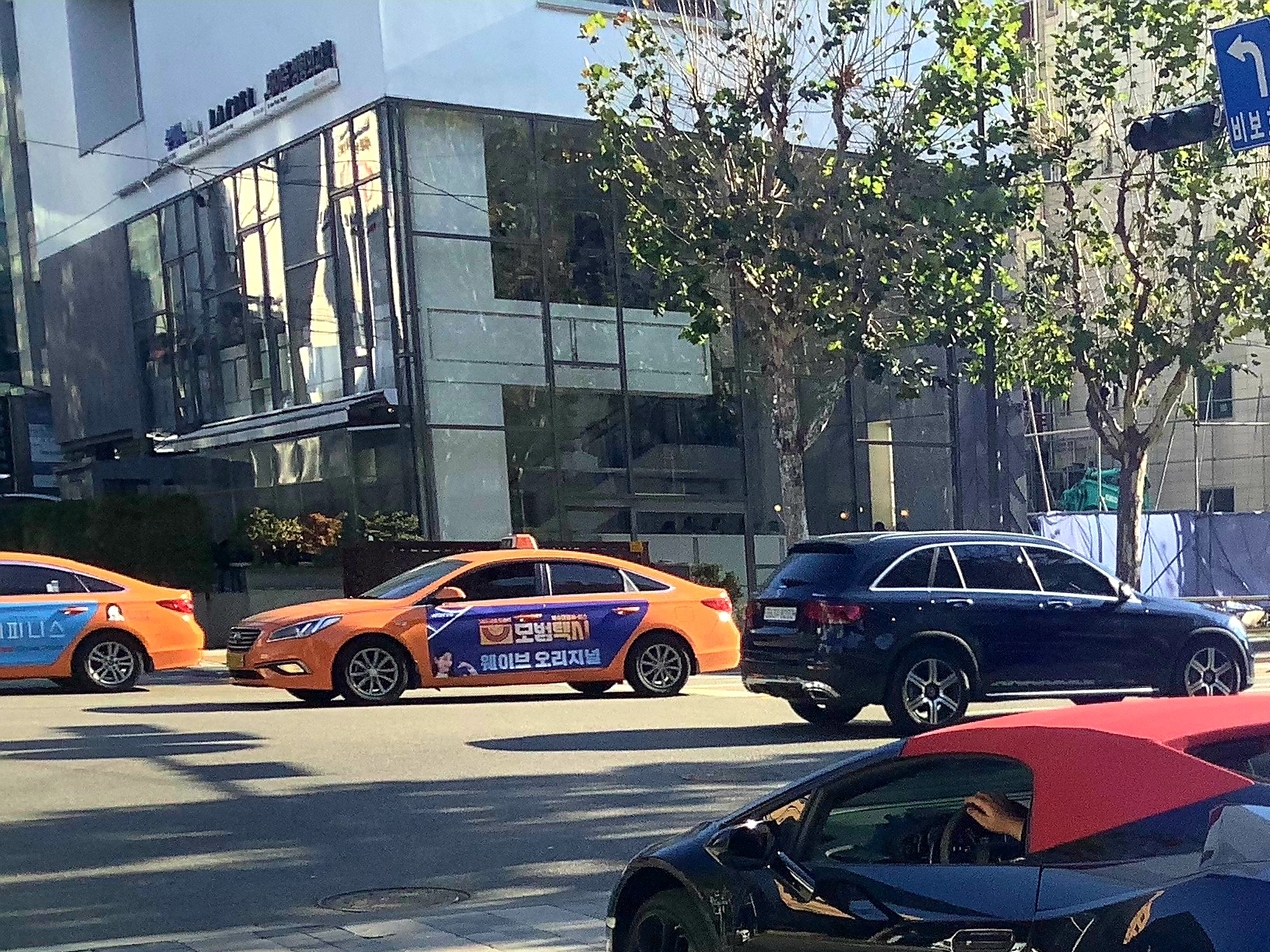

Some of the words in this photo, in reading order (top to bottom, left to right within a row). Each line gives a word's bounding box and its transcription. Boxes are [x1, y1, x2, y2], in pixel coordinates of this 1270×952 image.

[0, 620, 66, 640] 피니스
[514, 620, 589, 643] 모범택시
[480, 651, 532, 671] 웨이브
[535, 648, 601, 668] 오리지널
